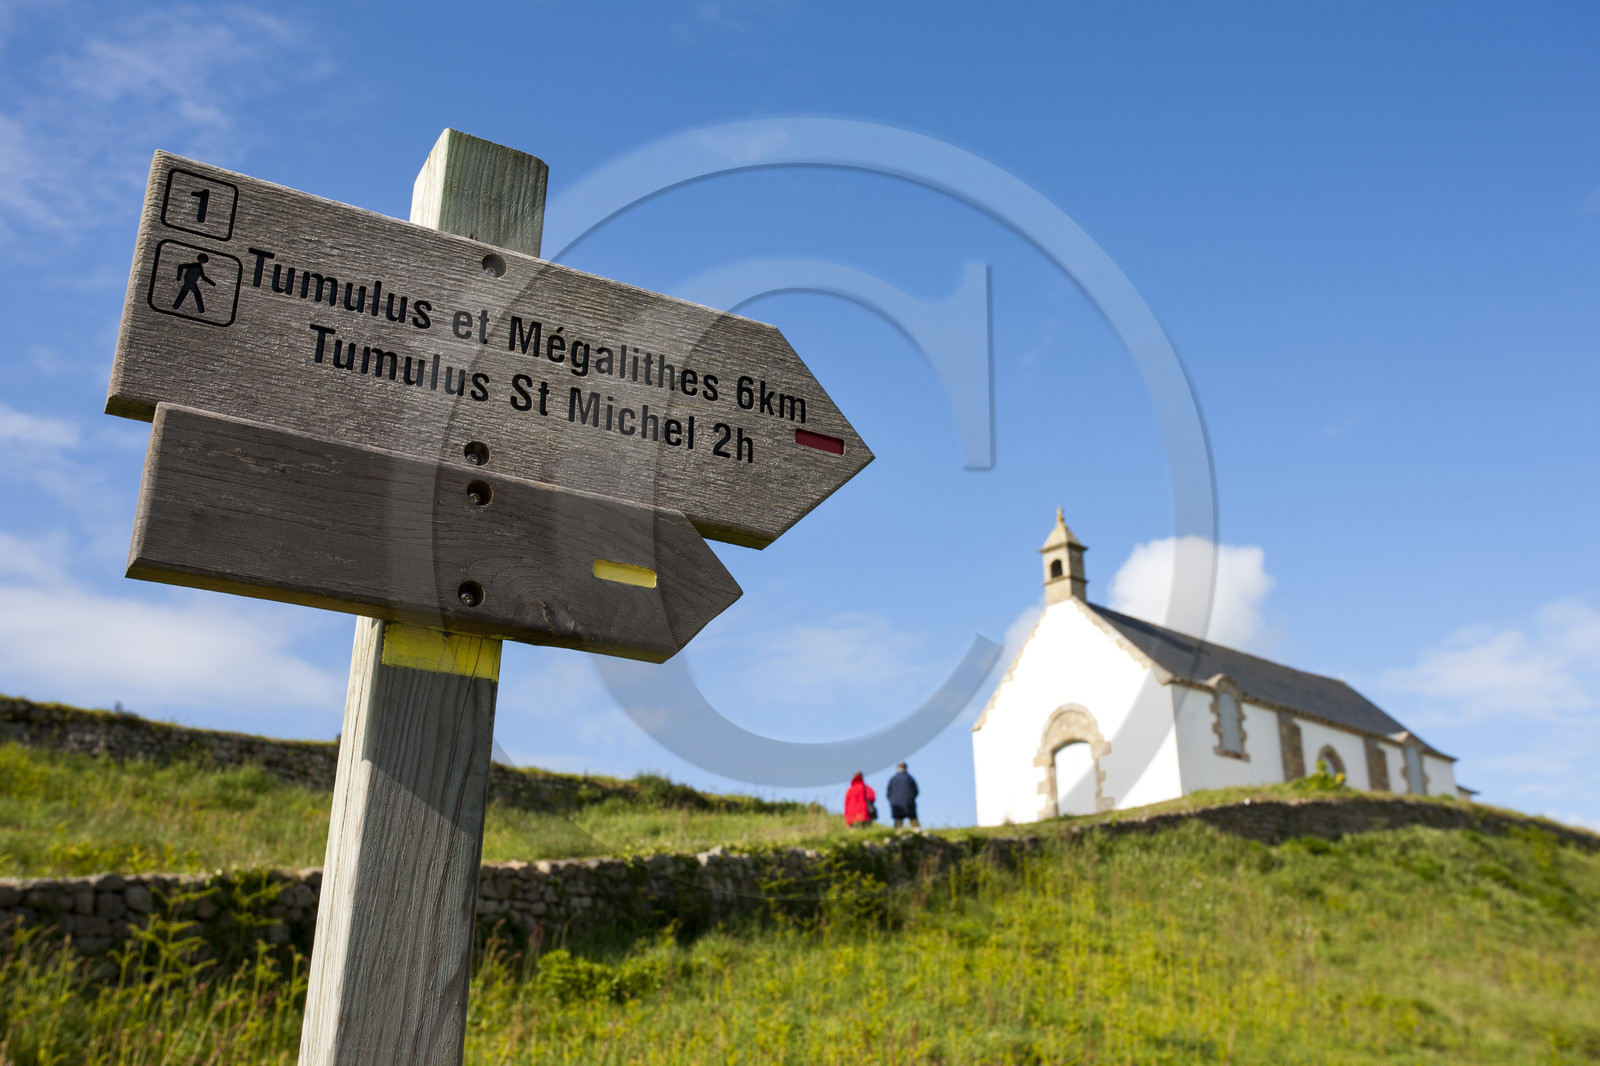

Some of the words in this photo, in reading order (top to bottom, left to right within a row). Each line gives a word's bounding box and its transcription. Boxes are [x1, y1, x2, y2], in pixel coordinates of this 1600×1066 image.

[191, 188, 210, 223] 1
[248, 247, 432, 329] Tumulus
[452, 310, 490, 344] et
[508, 315, 719, 401] Mégalithes
[736, 375, 807, 423] 6km
[310, 324, 490, 401] Tumulus
[511, 374, 549, 416] St
[568, 387, 695, 450] Michel
[713, 422, 754, 463] 2h
